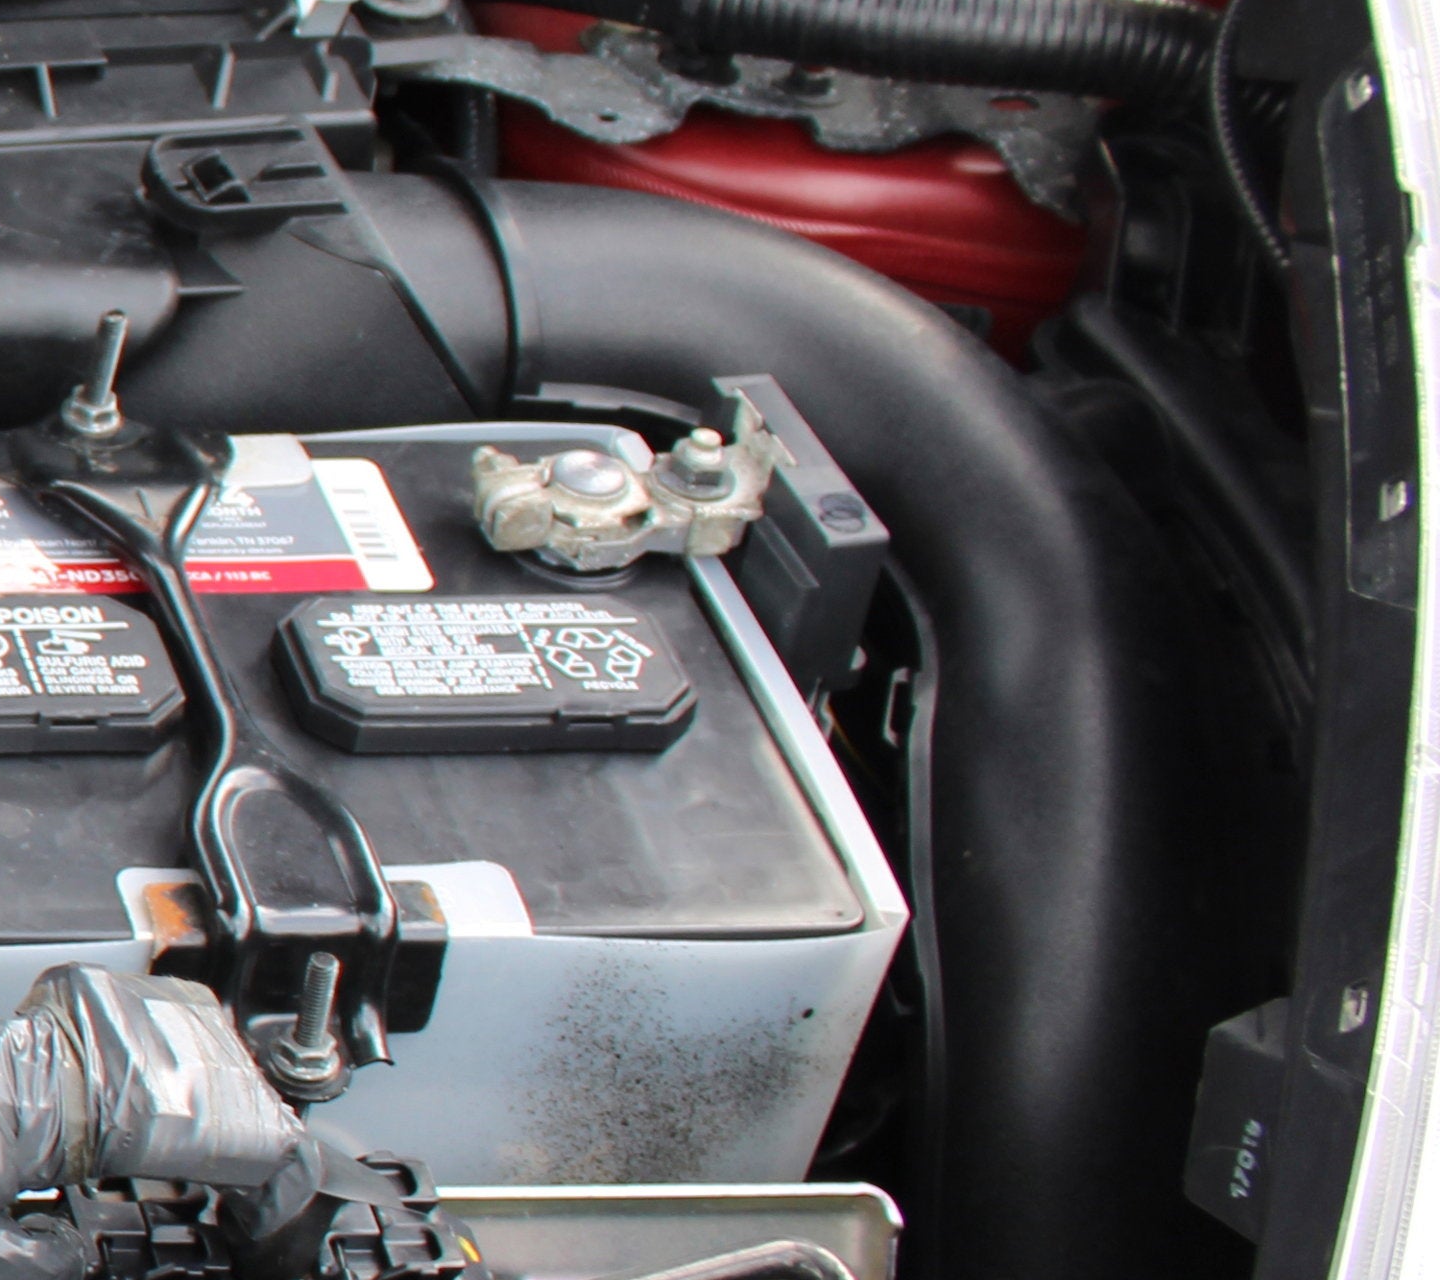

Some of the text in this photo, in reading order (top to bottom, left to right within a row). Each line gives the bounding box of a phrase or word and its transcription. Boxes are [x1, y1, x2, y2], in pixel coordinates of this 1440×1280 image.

[35, 655, 148, 668] SULFURIC ACID
[582, 680, 640, 691] RECYCLE
